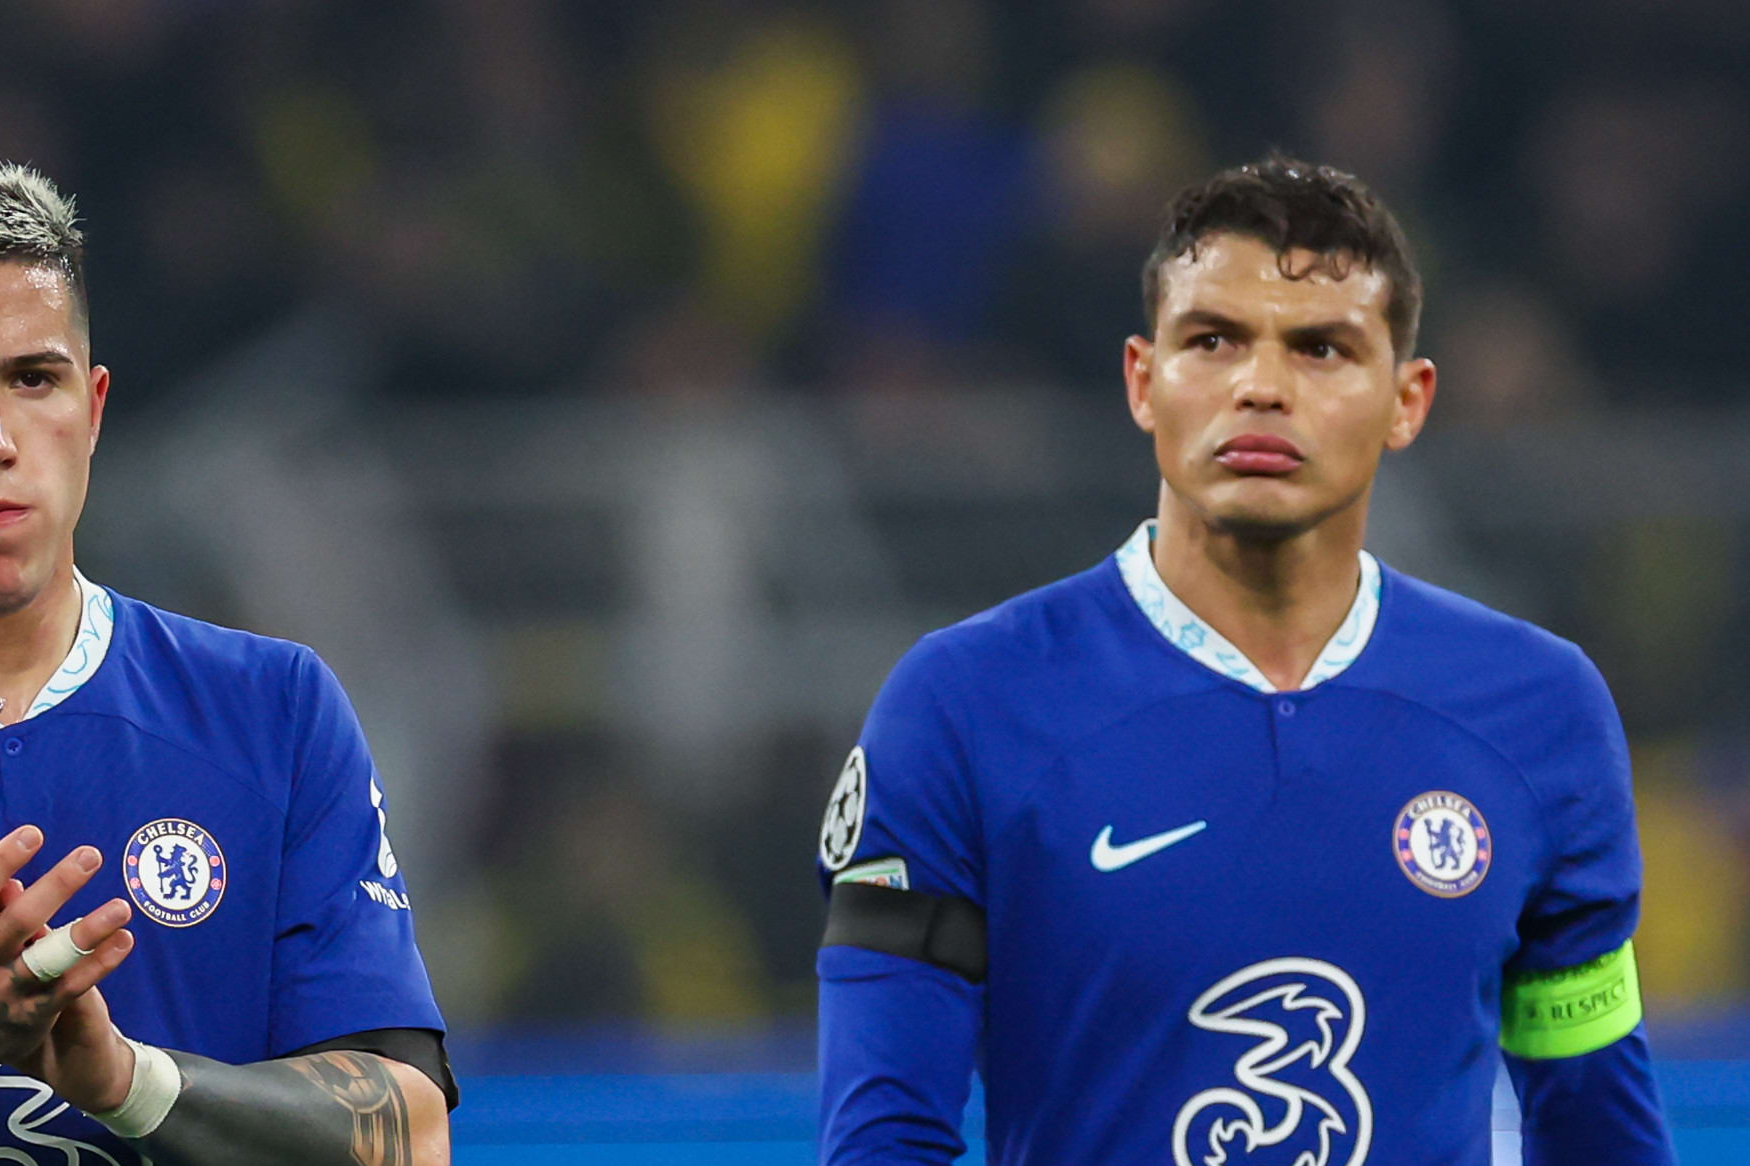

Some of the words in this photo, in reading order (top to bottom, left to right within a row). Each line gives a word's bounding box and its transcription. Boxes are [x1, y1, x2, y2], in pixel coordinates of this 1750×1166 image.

[137, 822, 204, 847] CHELSEA
[143, 900, 188, 922] FOOTBALL
[189, 901, 211, 919] CLUB
